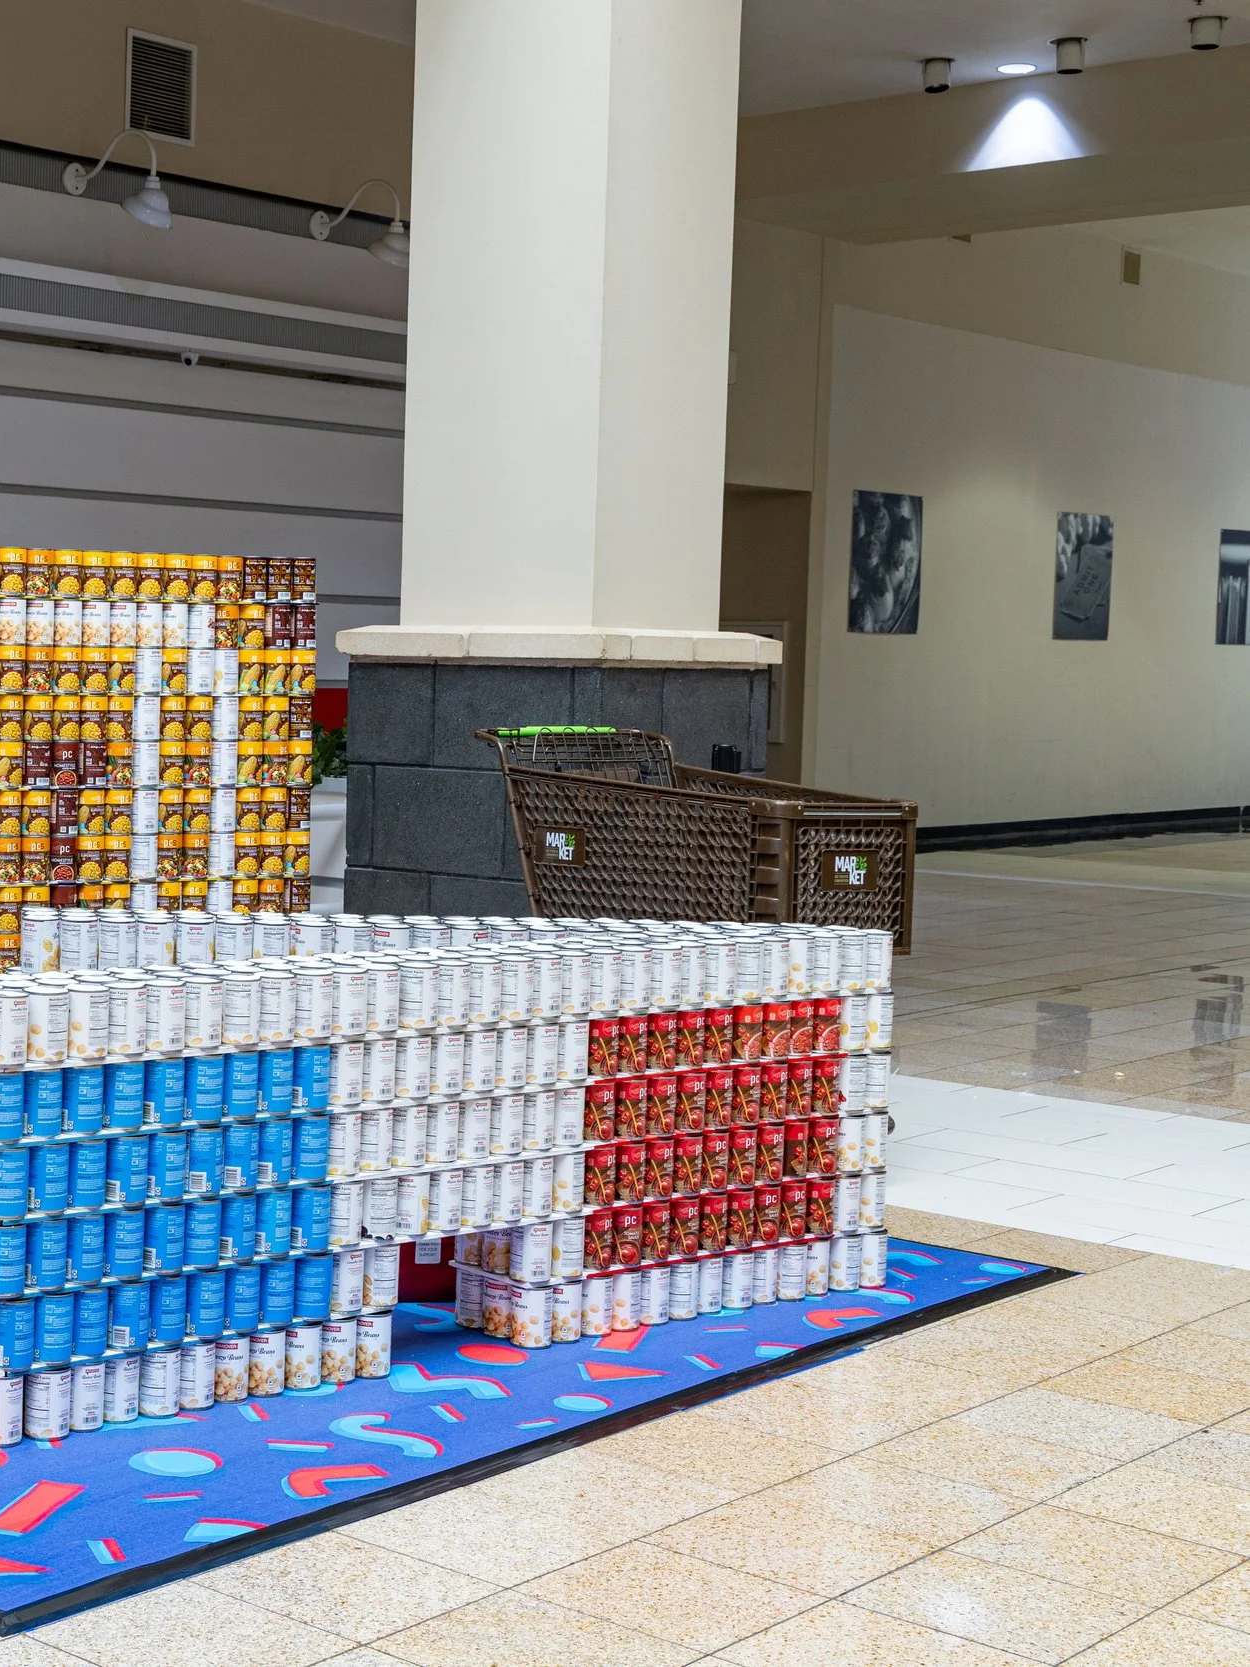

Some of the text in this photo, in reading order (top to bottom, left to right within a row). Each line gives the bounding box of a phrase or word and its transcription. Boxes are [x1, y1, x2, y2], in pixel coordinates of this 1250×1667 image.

[546, 832, 565, 847] MAR
[559, 847, 574, 860] KET
[835, 856, 856, 872] MAR
[849, 871, 866, 884] KET
